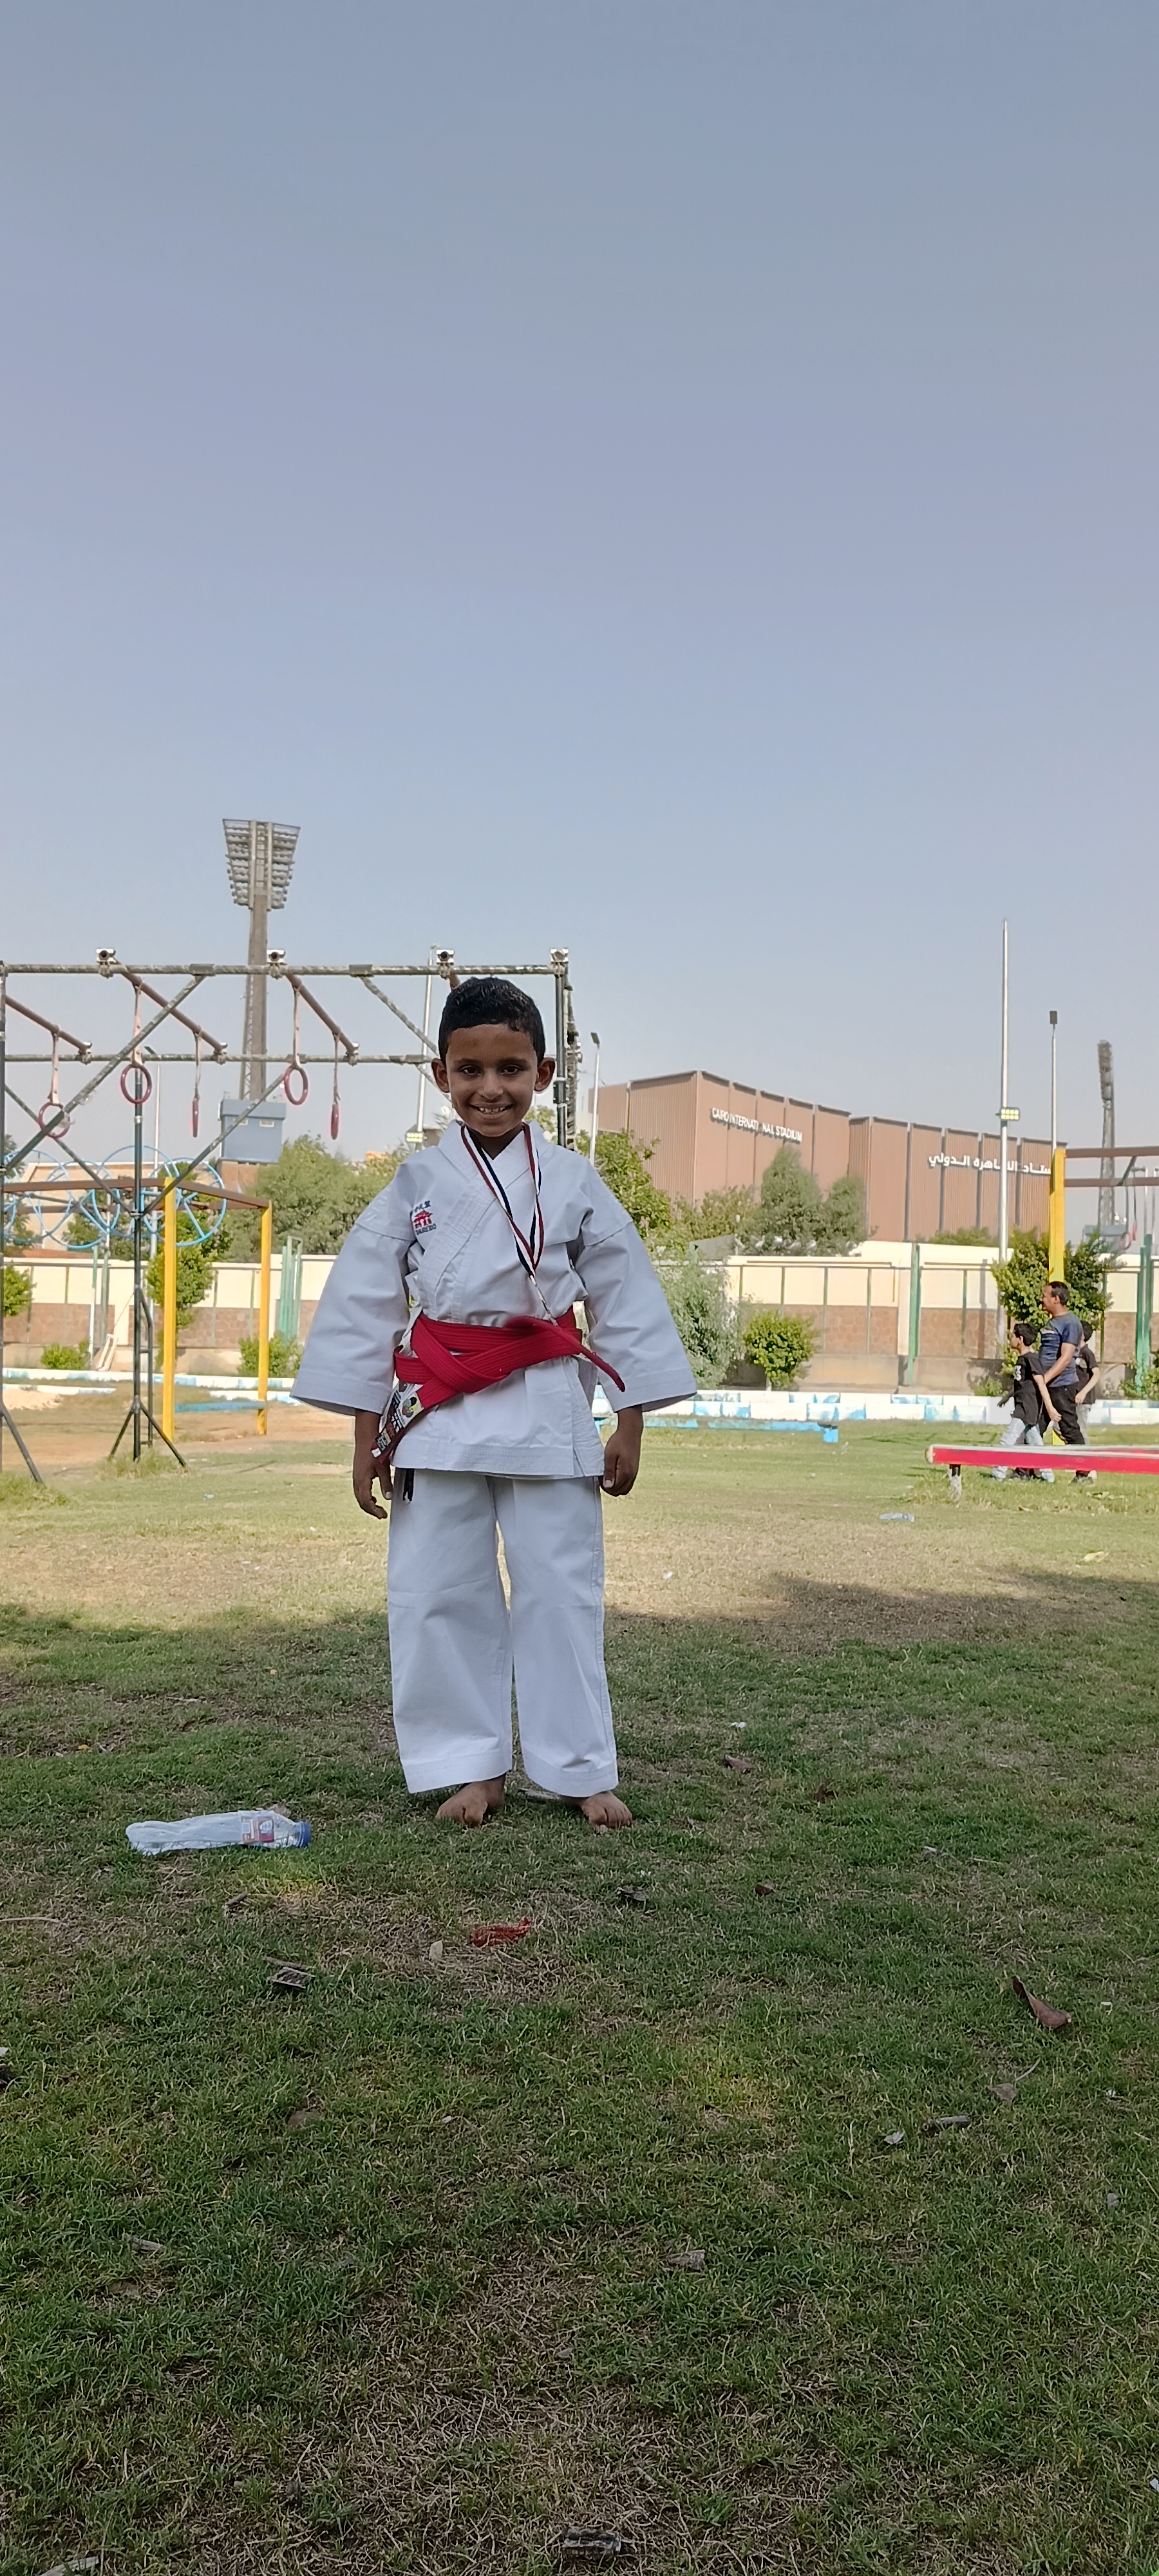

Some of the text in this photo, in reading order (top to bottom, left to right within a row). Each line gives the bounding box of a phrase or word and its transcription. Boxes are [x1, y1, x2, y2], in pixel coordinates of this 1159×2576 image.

[712, 1107, 802, 1142] CAIRO INTERNATINAL STADIUM
[928, 1152, 970, 1168] الدولي
[973, 1157, 1018, 1171] الاهرة
